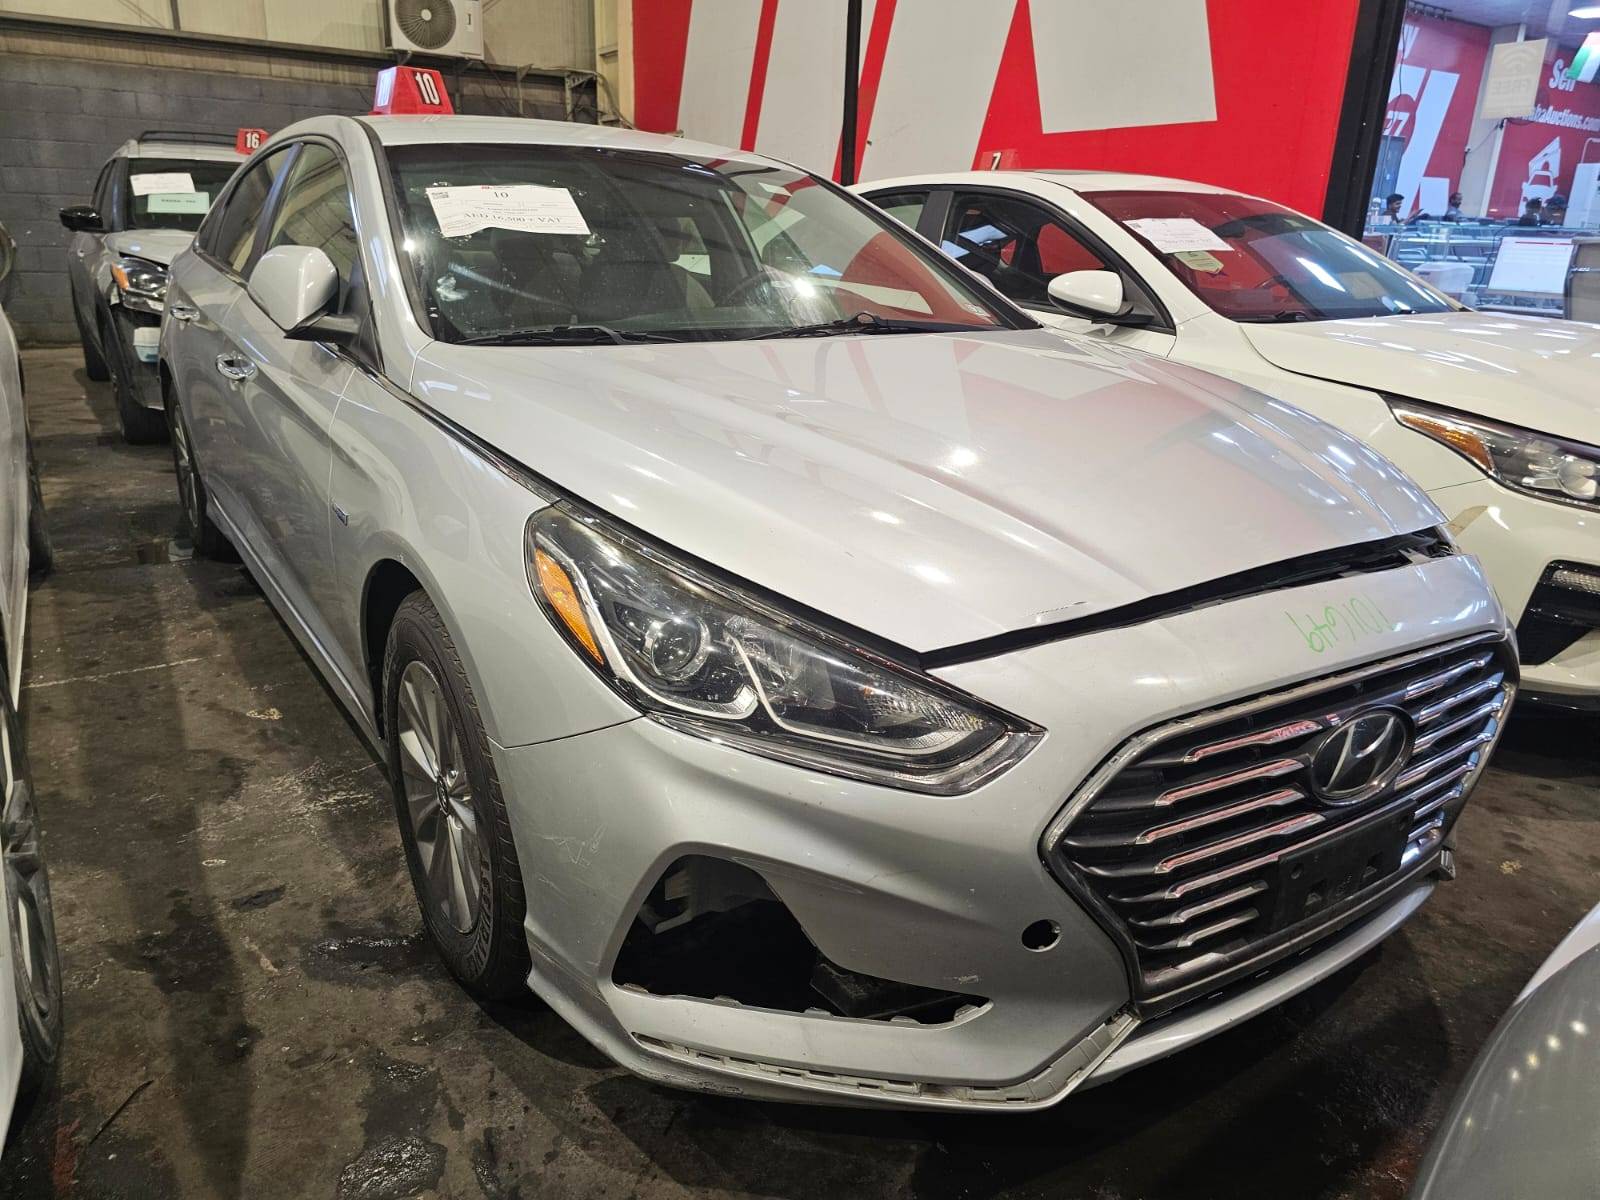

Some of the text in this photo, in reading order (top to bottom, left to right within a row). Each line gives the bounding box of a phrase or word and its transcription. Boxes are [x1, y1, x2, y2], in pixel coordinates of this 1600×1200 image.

[415, 72, 440, 105] 10
[246, 133, 260, 149] 16
[991, 152, 1002, 171] 7
[493, 191, 509, 199] 10
